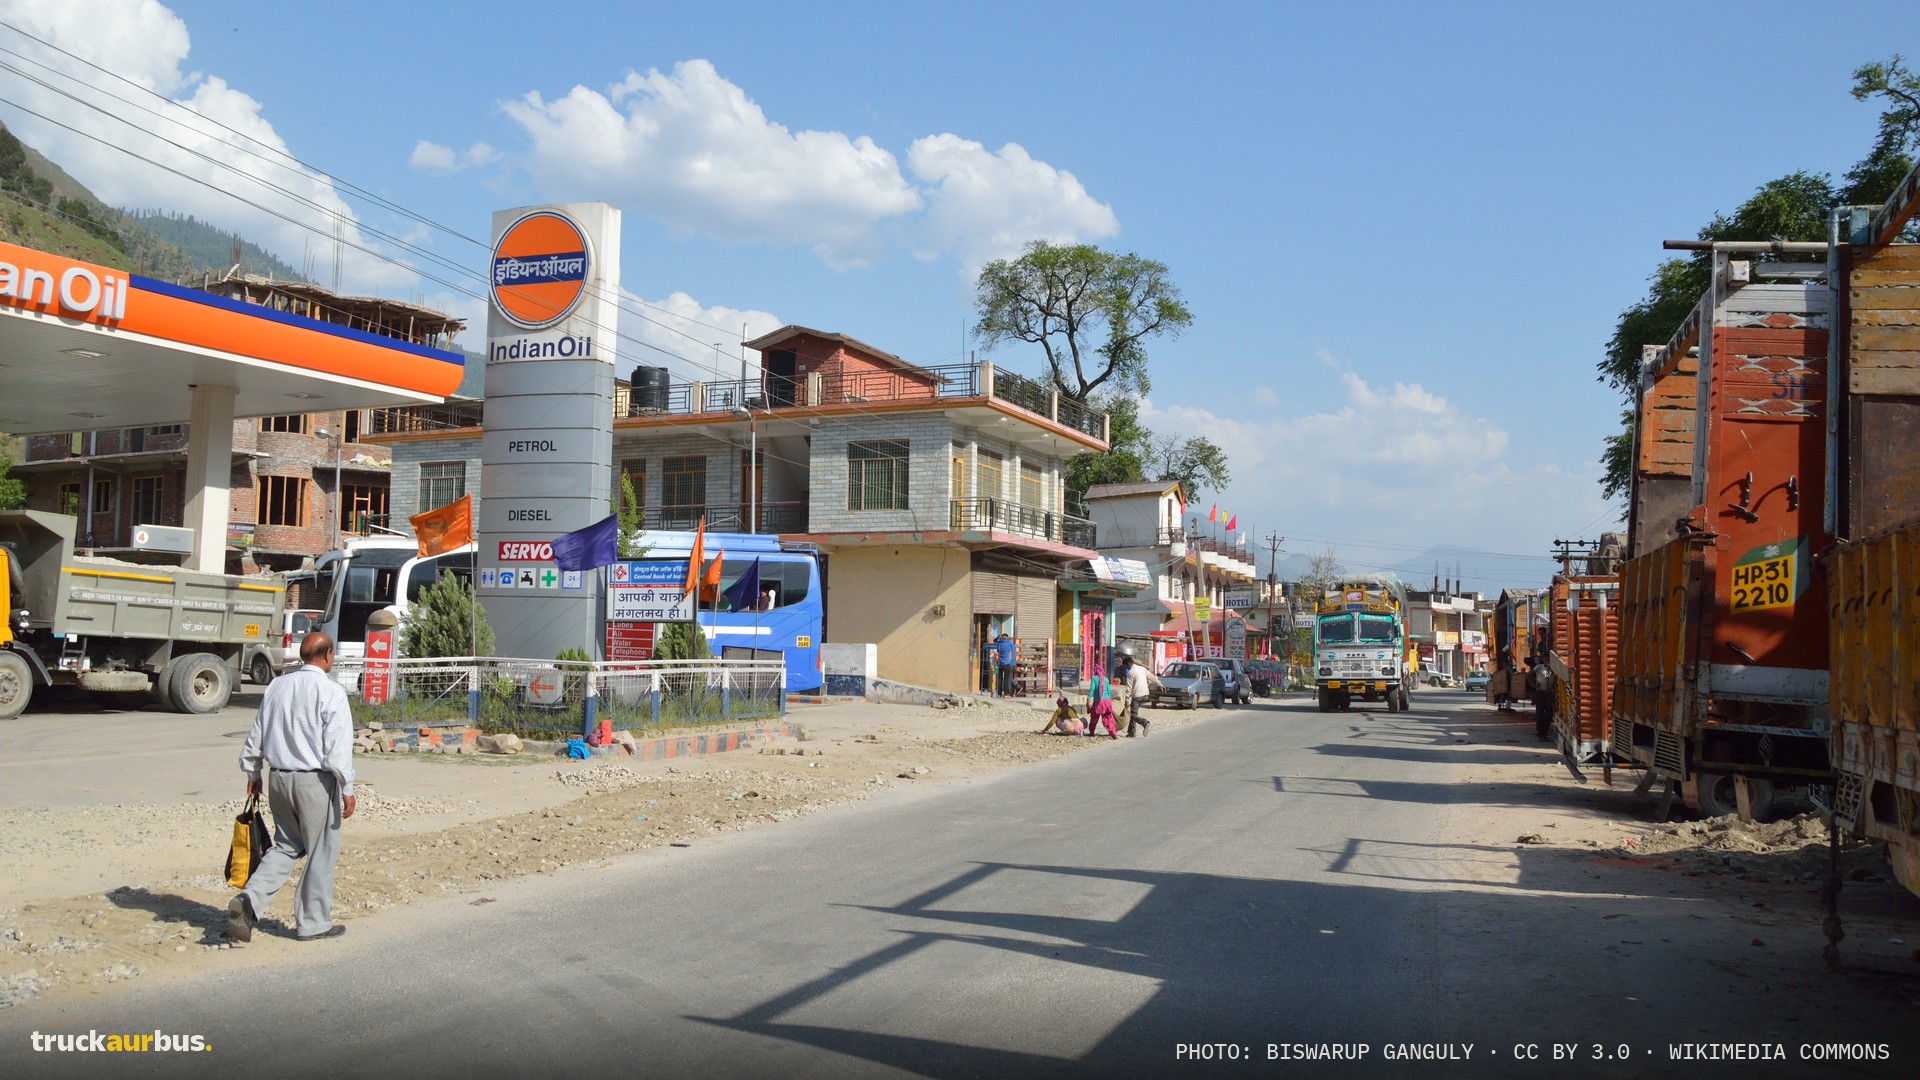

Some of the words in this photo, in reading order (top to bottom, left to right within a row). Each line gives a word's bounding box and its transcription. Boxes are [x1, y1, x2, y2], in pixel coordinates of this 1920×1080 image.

[495, 255, 584, 285] इंडियनऑयल
[489, 336, 592, 361] IndianOil
[508, 440, 558, 453] PETROL
[508, 509, 552, 521] DIESEL
[138, 532, 145, 542] 4
[500, 542, 554, 560] SERVO
[618, 589, 655, 602] आपकी
[615, 605, 664, 618] मंगलमय
[613, 639, 632, 647] Water
